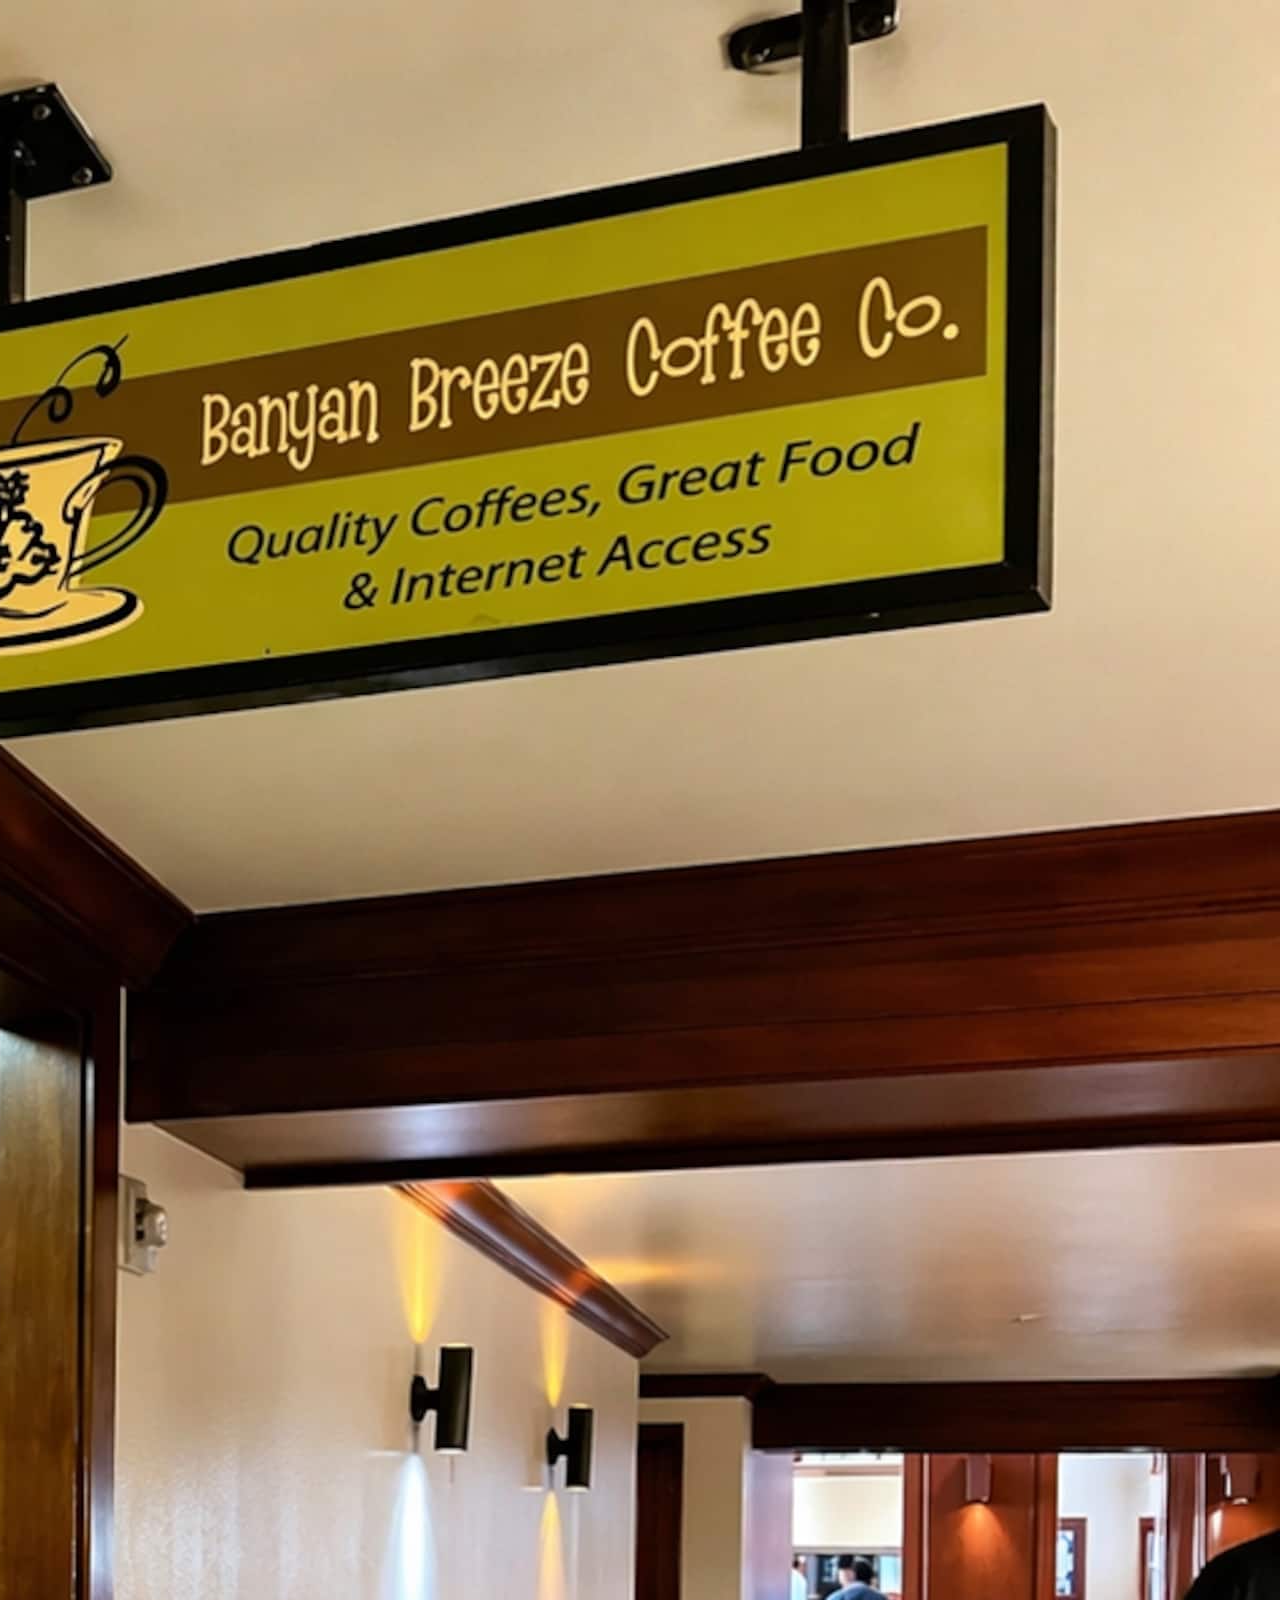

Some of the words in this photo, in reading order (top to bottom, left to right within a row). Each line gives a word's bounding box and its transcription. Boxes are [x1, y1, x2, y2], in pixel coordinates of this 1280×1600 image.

[200, 379, 380, 471] Banyan
[408, 340, 590, 432] Breeze
[626, 298, 821, 397] Coffee
[859, 276, 960, 358] Co.
[226, 511, 398, 566] Quality
[411, 483, 601, 537] Coffees,
[617, 452, 766, 505] Great
[778, 421, 921, 484] Food
[342, 573, 378, 610] &
[391, 545, 585, 606] Internet
[597, 523, 772, 576] Access
